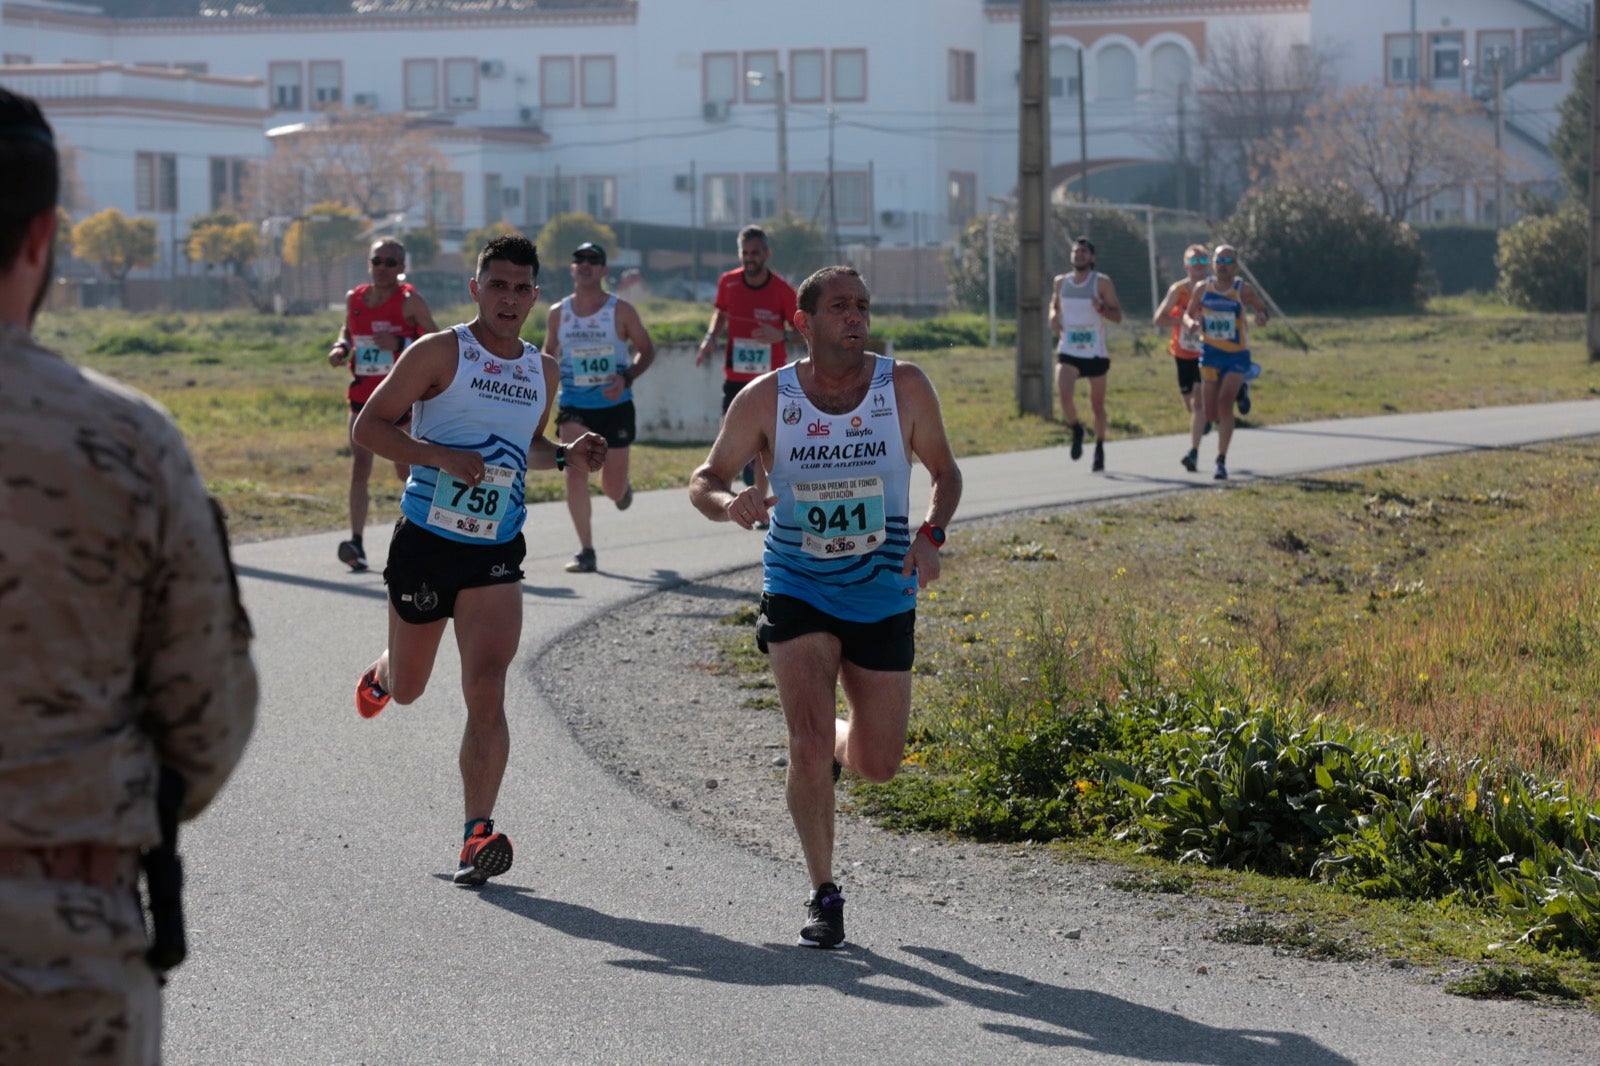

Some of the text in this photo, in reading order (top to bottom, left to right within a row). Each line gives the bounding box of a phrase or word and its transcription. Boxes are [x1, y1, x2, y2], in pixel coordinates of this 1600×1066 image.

[362, 348, 380, 362] 47
[738, 348, 764, 362] 637
[581, 358, 609, 373] 140
[470, 377, 538, 402] MARACENA
[807, 418, 832, 437] als
[790, 441, 887, 461] MARACENA
[801, 460, 876, 470] CLUB DE ATLETISMO
[811, 482, 826, 492] GRAN
[827, 480, 849, 491] PREMIO
[850, 480, 857, 489] DE
[858, 478, 877, 488] FONDO
[451, 481, 499, 516] 758
[820, 489, 854, 500] DIPUTACIÓN
[808, 503, 867, 534] 941
